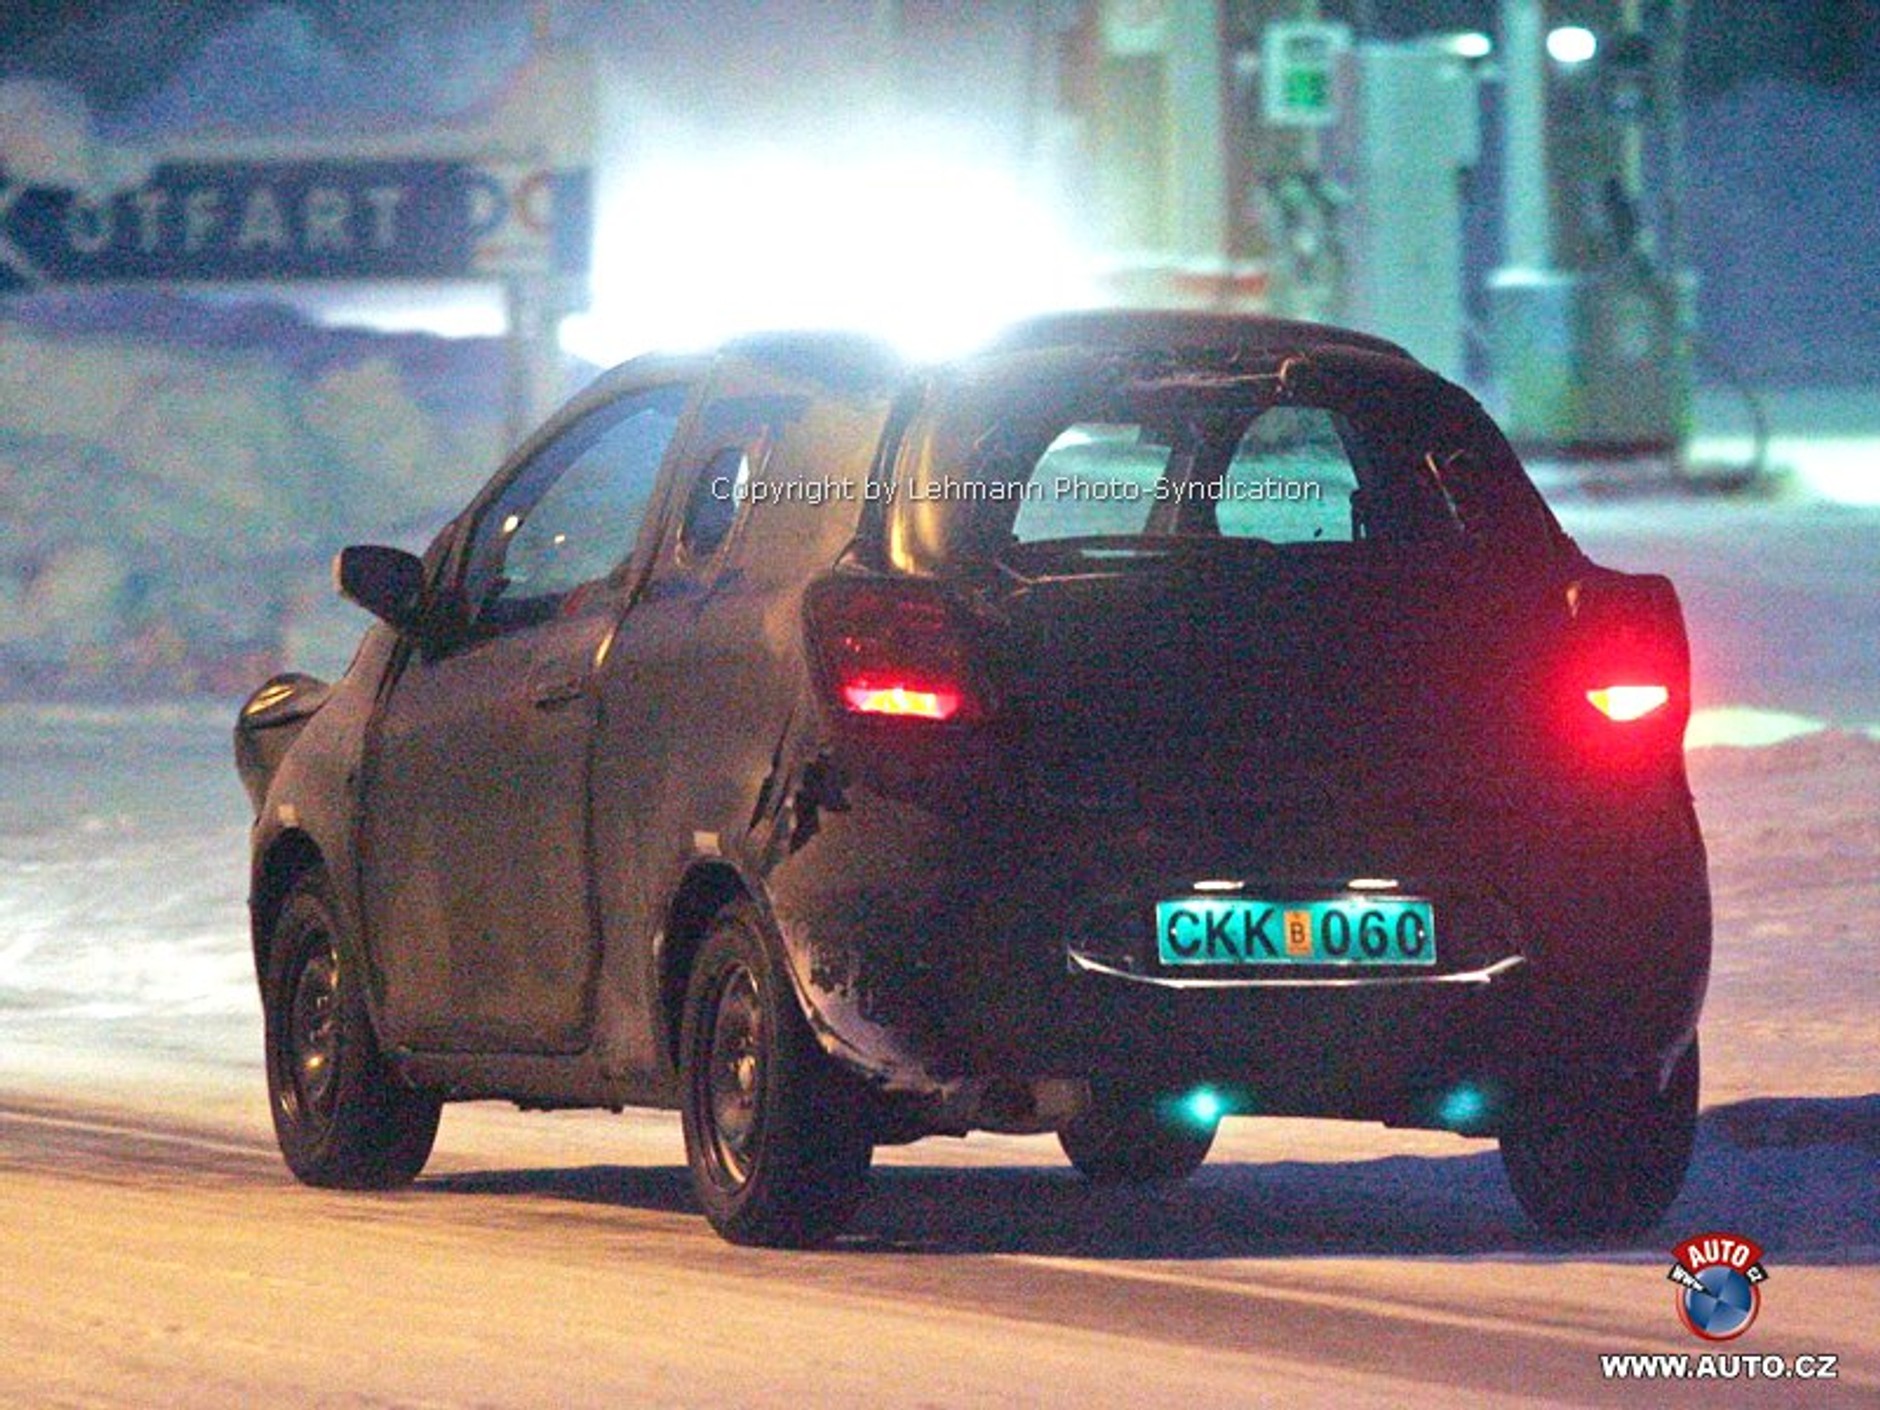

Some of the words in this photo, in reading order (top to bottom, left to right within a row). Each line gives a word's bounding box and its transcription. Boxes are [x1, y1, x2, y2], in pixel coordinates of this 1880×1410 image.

[66, 186, 406, 253] UTFART
[1167, 908, 1280, 957] CKK
[1290, 921, 1306, 944] B
[1320, 909, 1426, 956] 060
